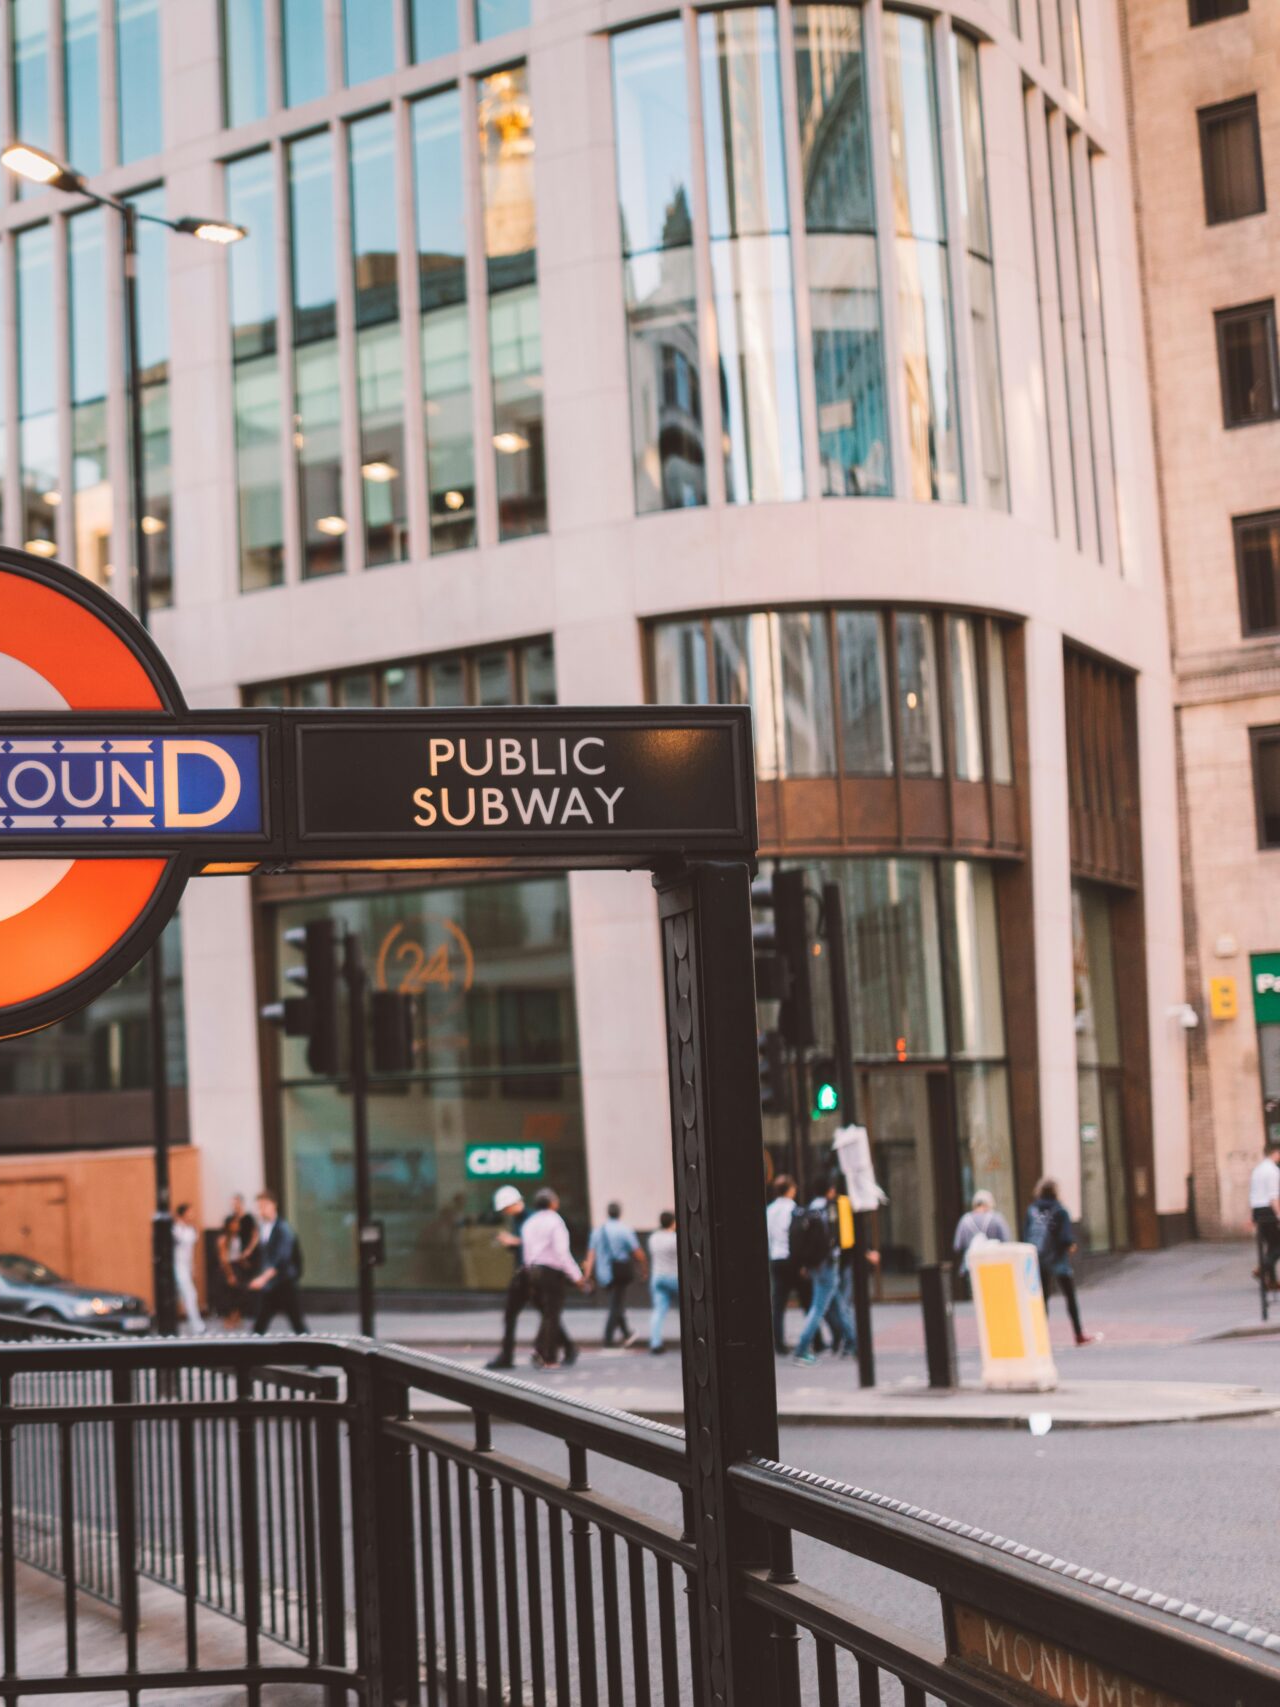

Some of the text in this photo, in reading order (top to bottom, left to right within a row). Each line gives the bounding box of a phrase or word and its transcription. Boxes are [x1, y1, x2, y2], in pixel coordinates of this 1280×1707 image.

[429, 736, 606, 777] PUBLIC
[412, 787, 625, 827] SUBWAY
[467, 1147, 541, 1174] CBRE
